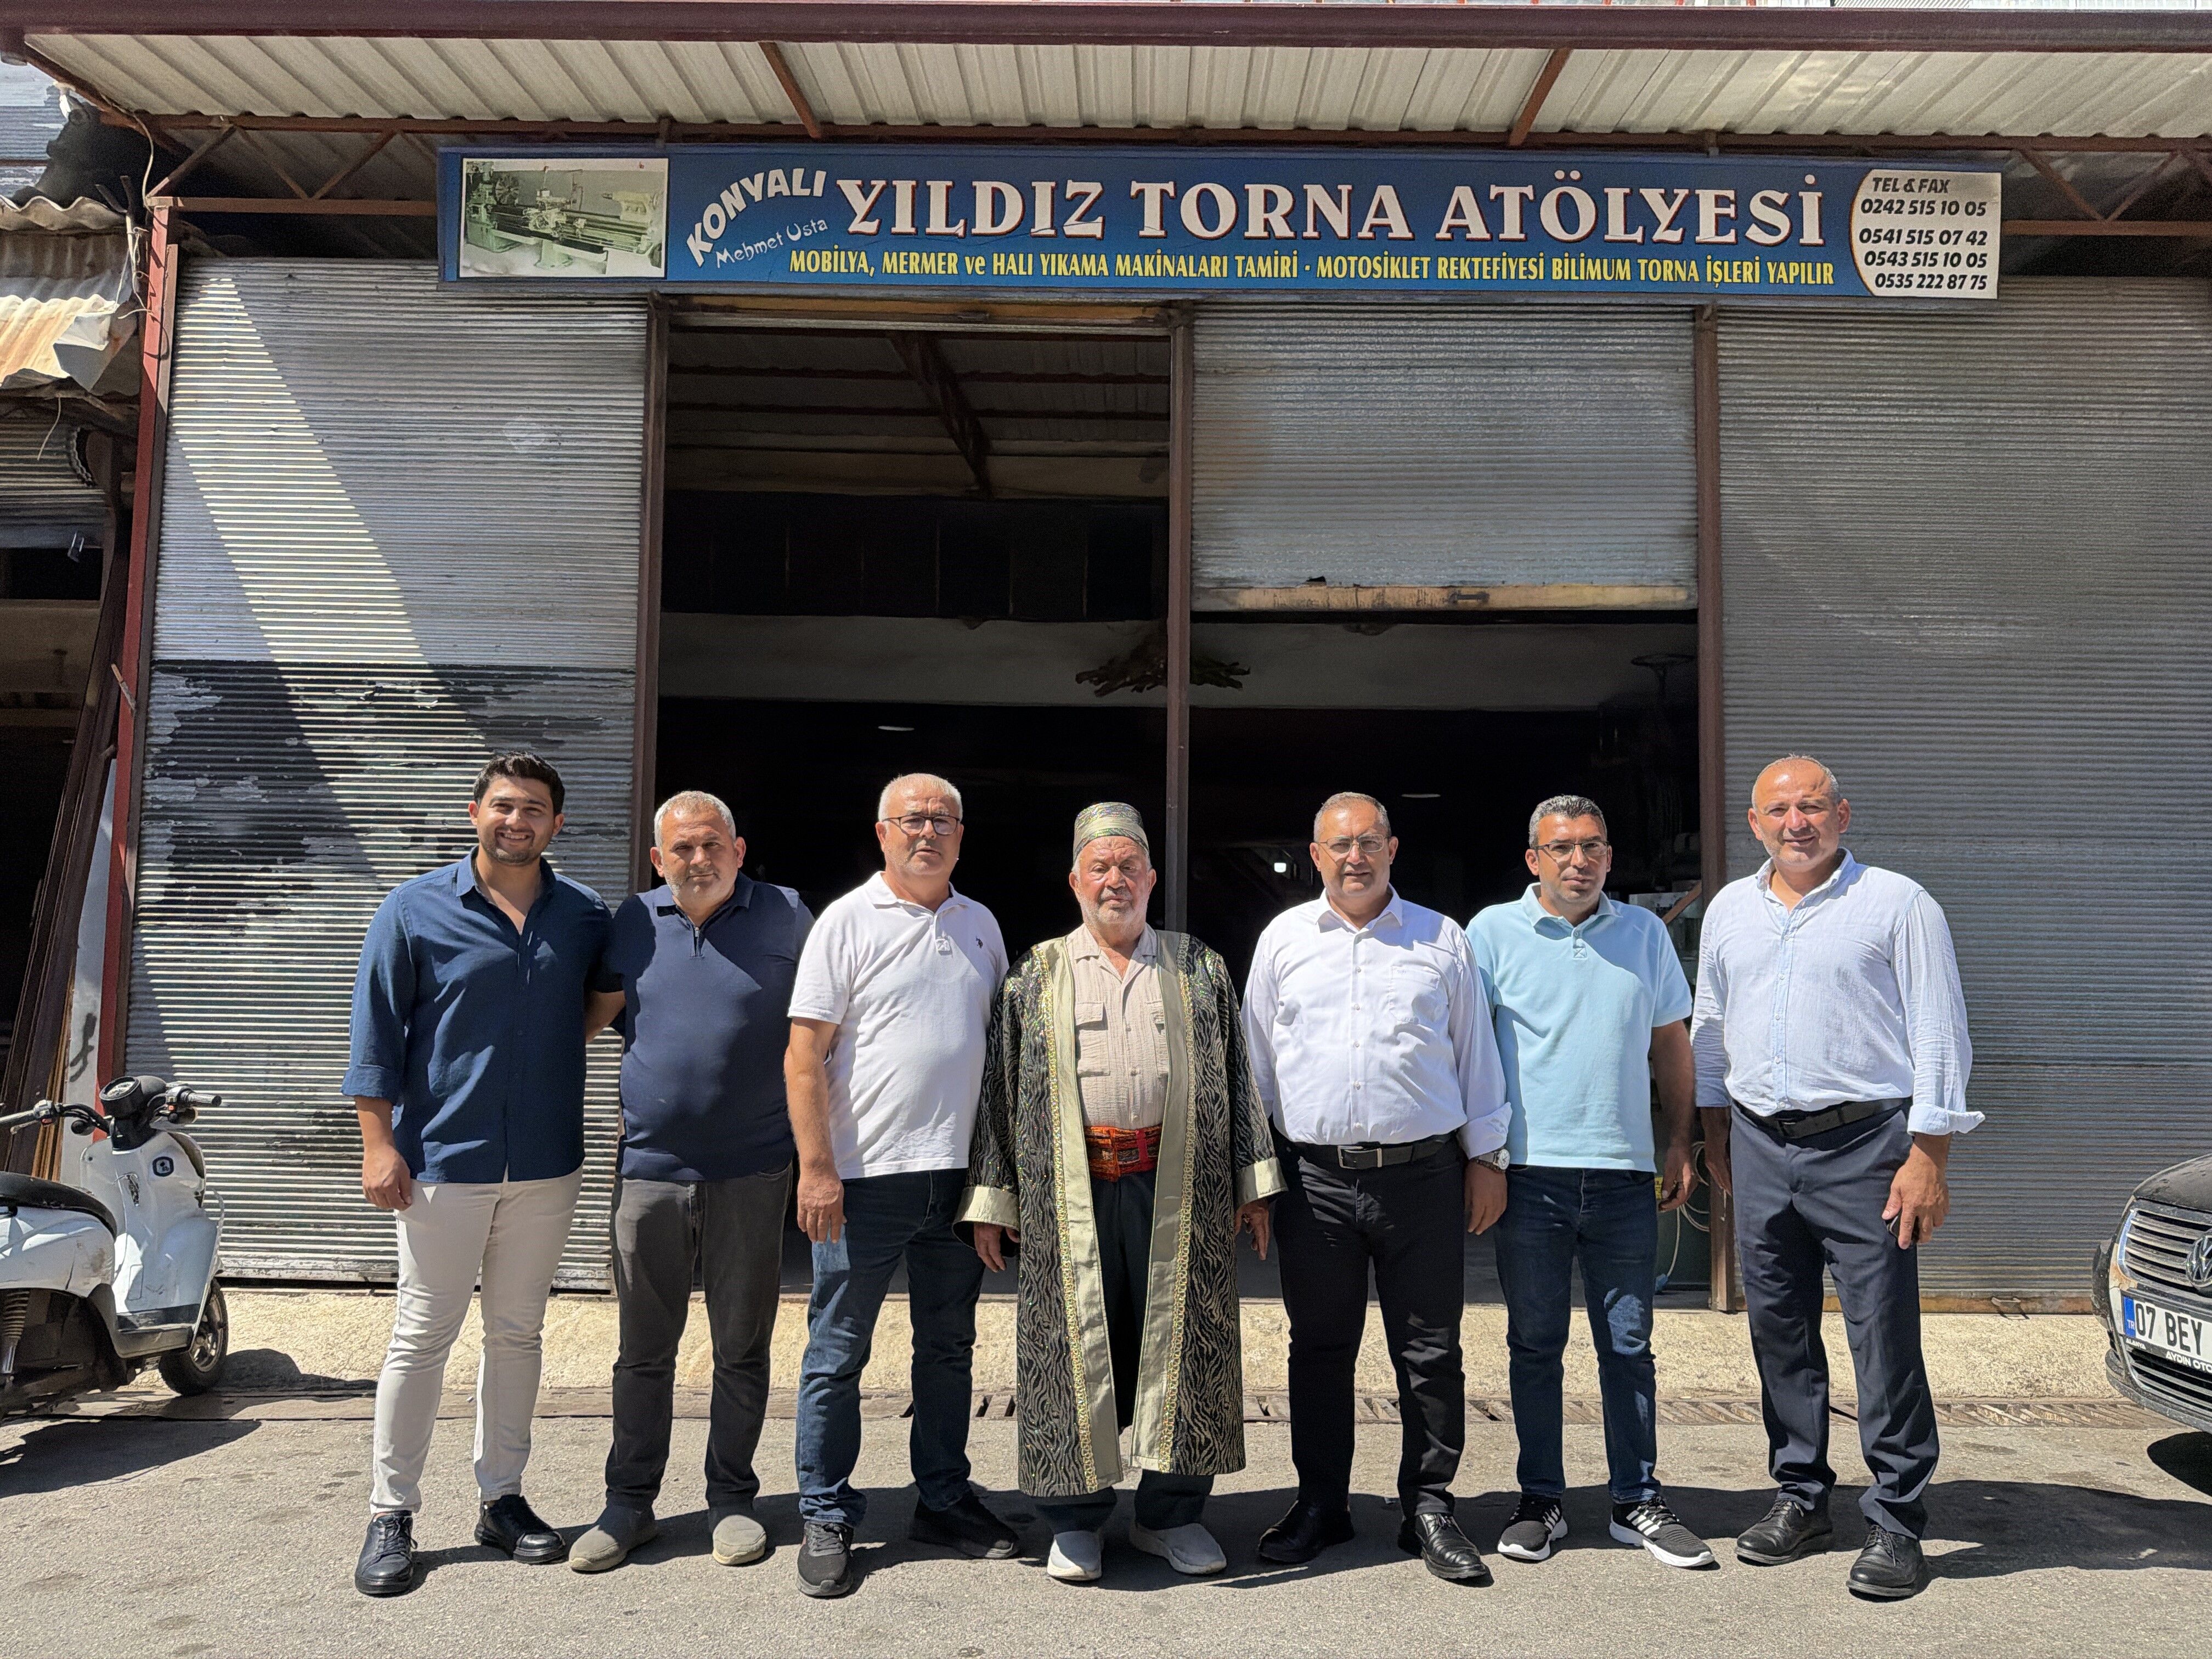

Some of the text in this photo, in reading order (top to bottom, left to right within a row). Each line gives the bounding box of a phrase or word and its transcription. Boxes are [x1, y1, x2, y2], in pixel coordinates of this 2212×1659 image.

[1872, 177, 1899, 192] TEL
[1918, 179, 1951, 194] FAX
[836, 170, 1825, 247] YILDIZ TORNA ATÖLYESİ
[1861, 199, 1987, 216] 0242 515 10 05
[686, 168, 827, 267] KONYALI
[716, 219, 828, 268] Mehmet Usta
[1859, 228, 1988, 245] 0541 515 07 42
[790, 244, 1835, 288] MOBİLYA, MERMER ve HALI YIKAMA MAKİNALARI TAMİRİ MOTOSİKLET REKTEFİYESİ BİLİMUM TORNA İŞLERİ YAPILIR
[1864, 251, 1988, 268] 0543 515 10 05
[1875, 273, 1988, 290] 0535 222 87 75
[2126, 1319, 2135, 1330] TR
[2135, 1303, 2203, 1356] 07 BEY
[2165, 1351, 2192, 1367] AYDIN
